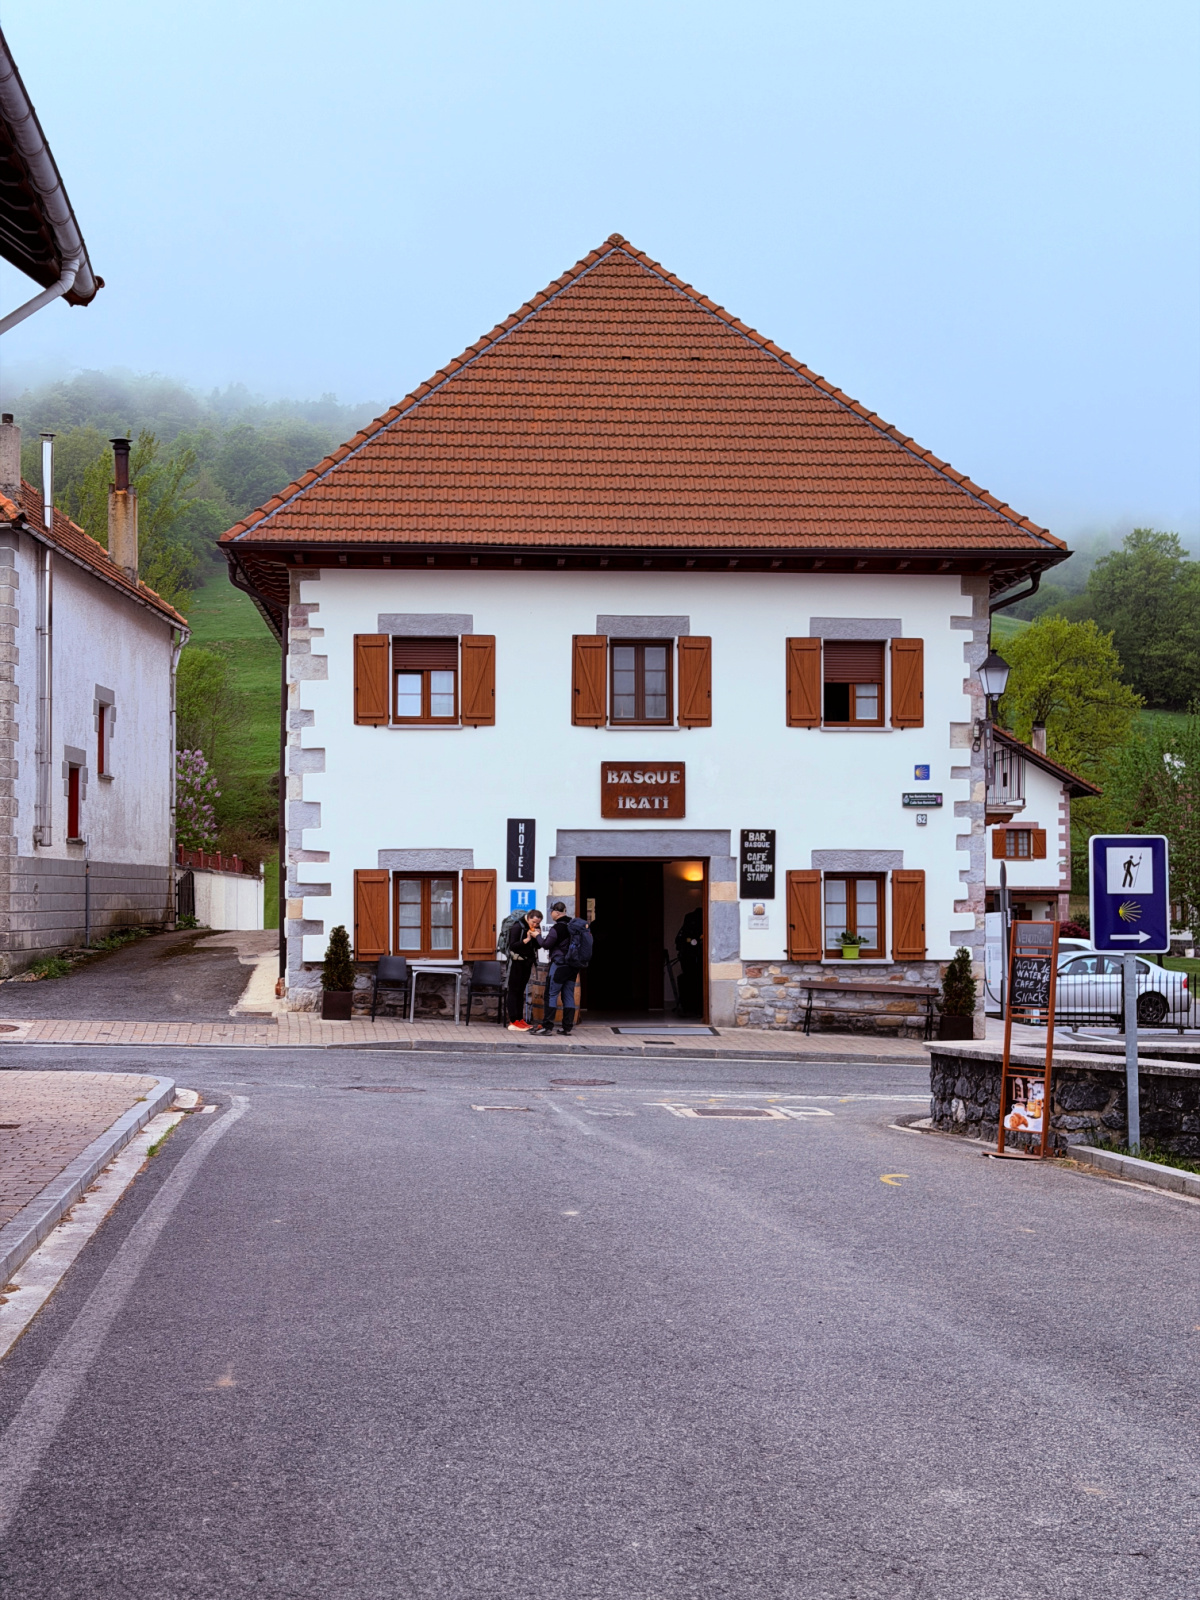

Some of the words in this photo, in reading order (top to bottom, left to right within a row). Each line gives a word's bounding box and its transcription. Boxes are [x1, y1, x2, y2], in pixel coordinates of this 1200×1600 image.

[606, 770, 681, 785] BASQUE
[917, 814, 927, 824] 82
[748, 832, 767, 841] BAR
[517, 822, 525, 879] HOTEL
[746, 850, 768, 861] CAFÉ
[742, 863, 773, 873] PILGRIM
[746, 873, 769, 882] STAMP
[516, 890, 530, 905] H
[1015, 960, 1038, 970] AGUA
[1016, 969, 1042, 981] WATER
[1014, 979, 1034, 989] CAFE
[1015, 991, 1049, 1004] SNACKS
